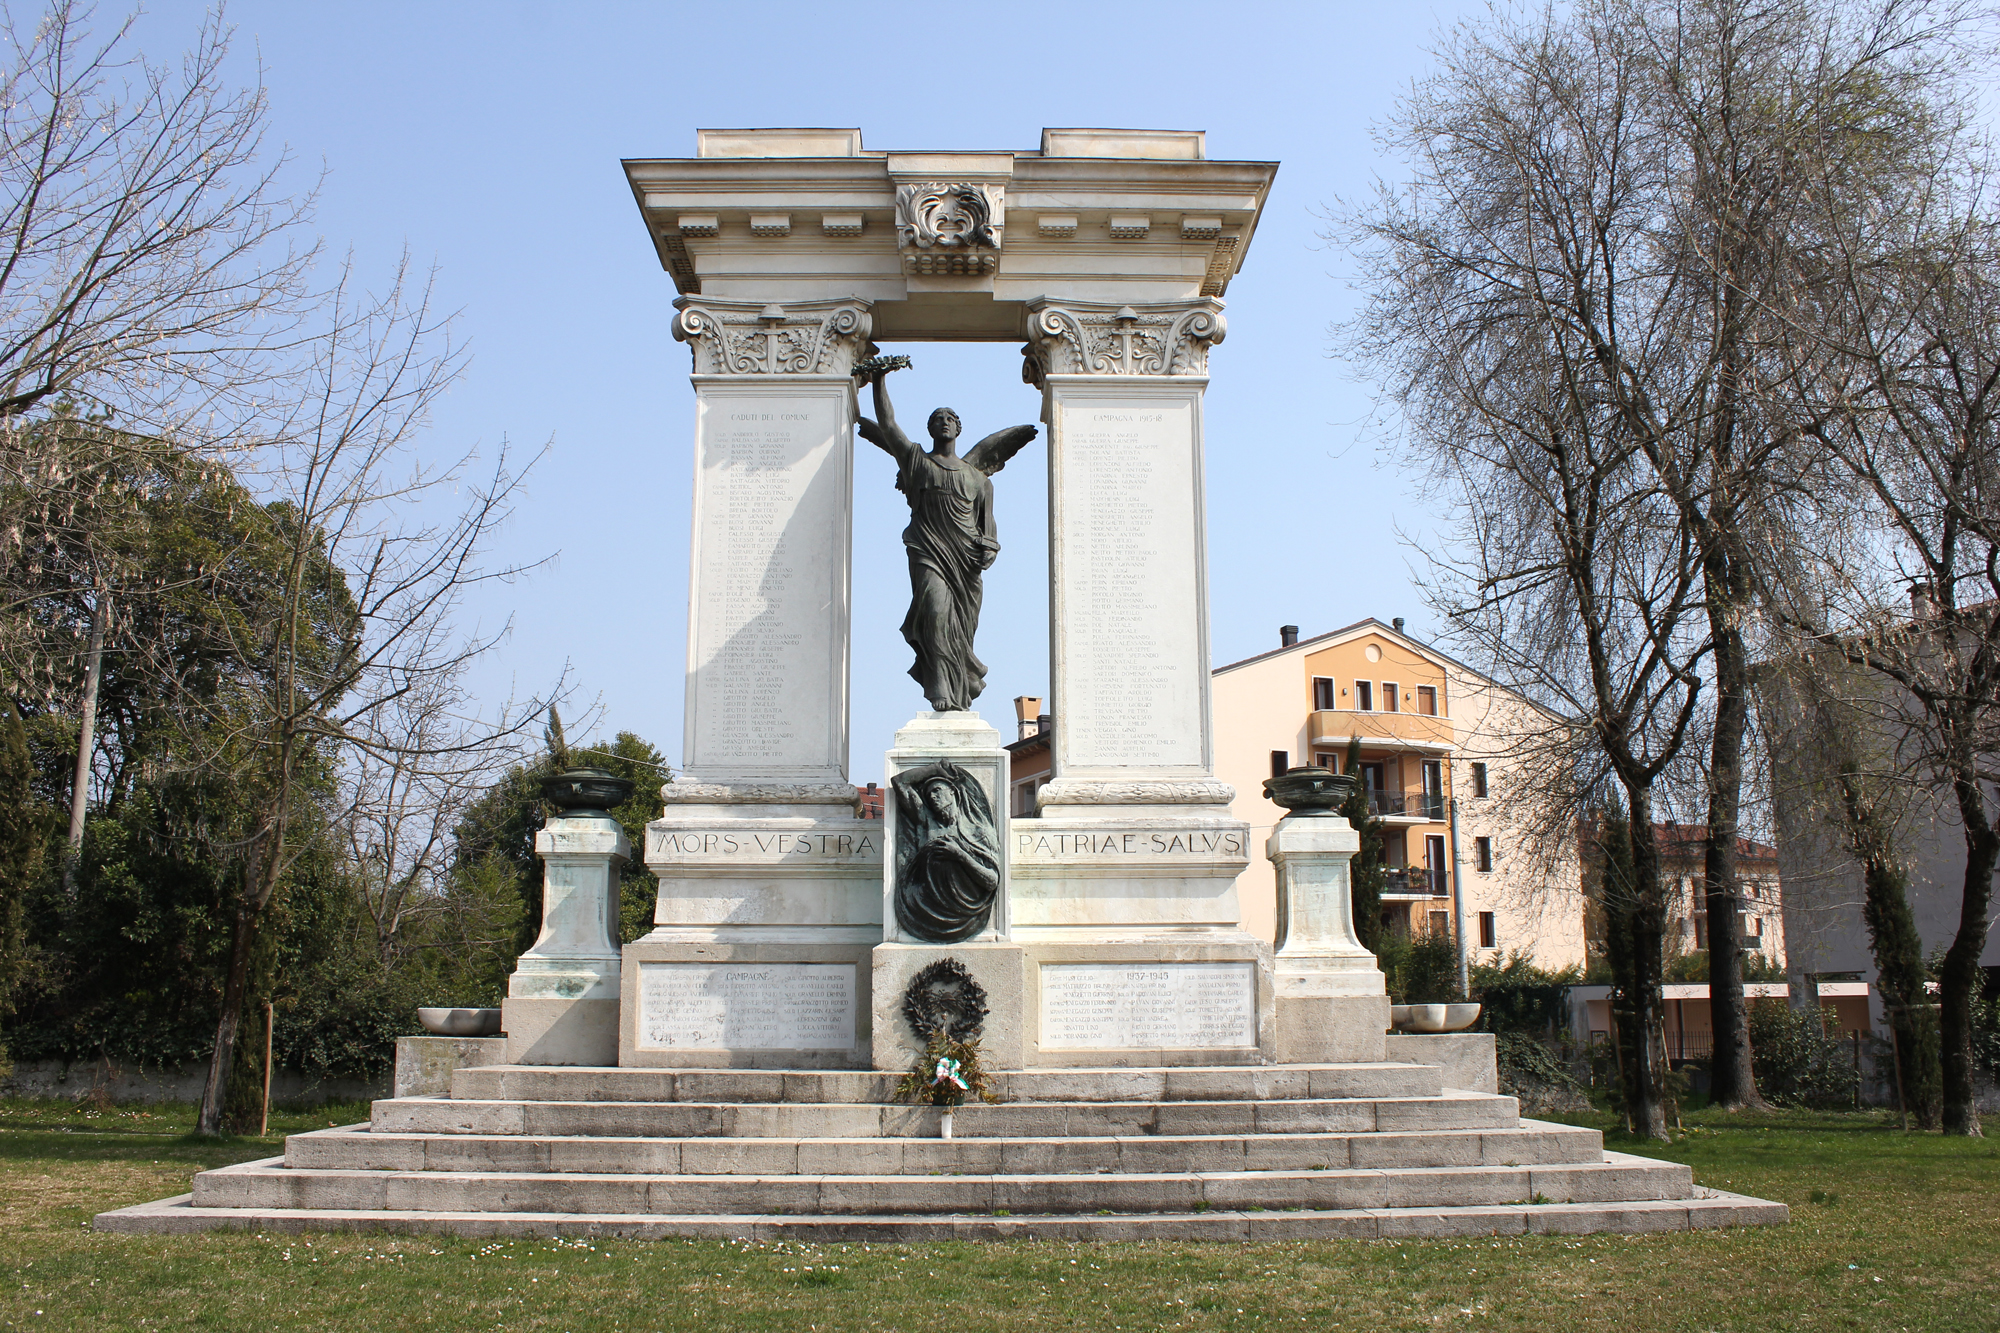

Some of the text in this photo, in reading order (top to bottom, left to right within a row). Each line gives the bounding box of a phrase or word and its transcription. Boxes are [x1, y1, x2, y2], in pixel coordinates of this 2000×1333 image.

[1093, 413, 1163, 422] CAMPAGNA 1915-18
[1126, 972, 1169, 981] 1937-1945
